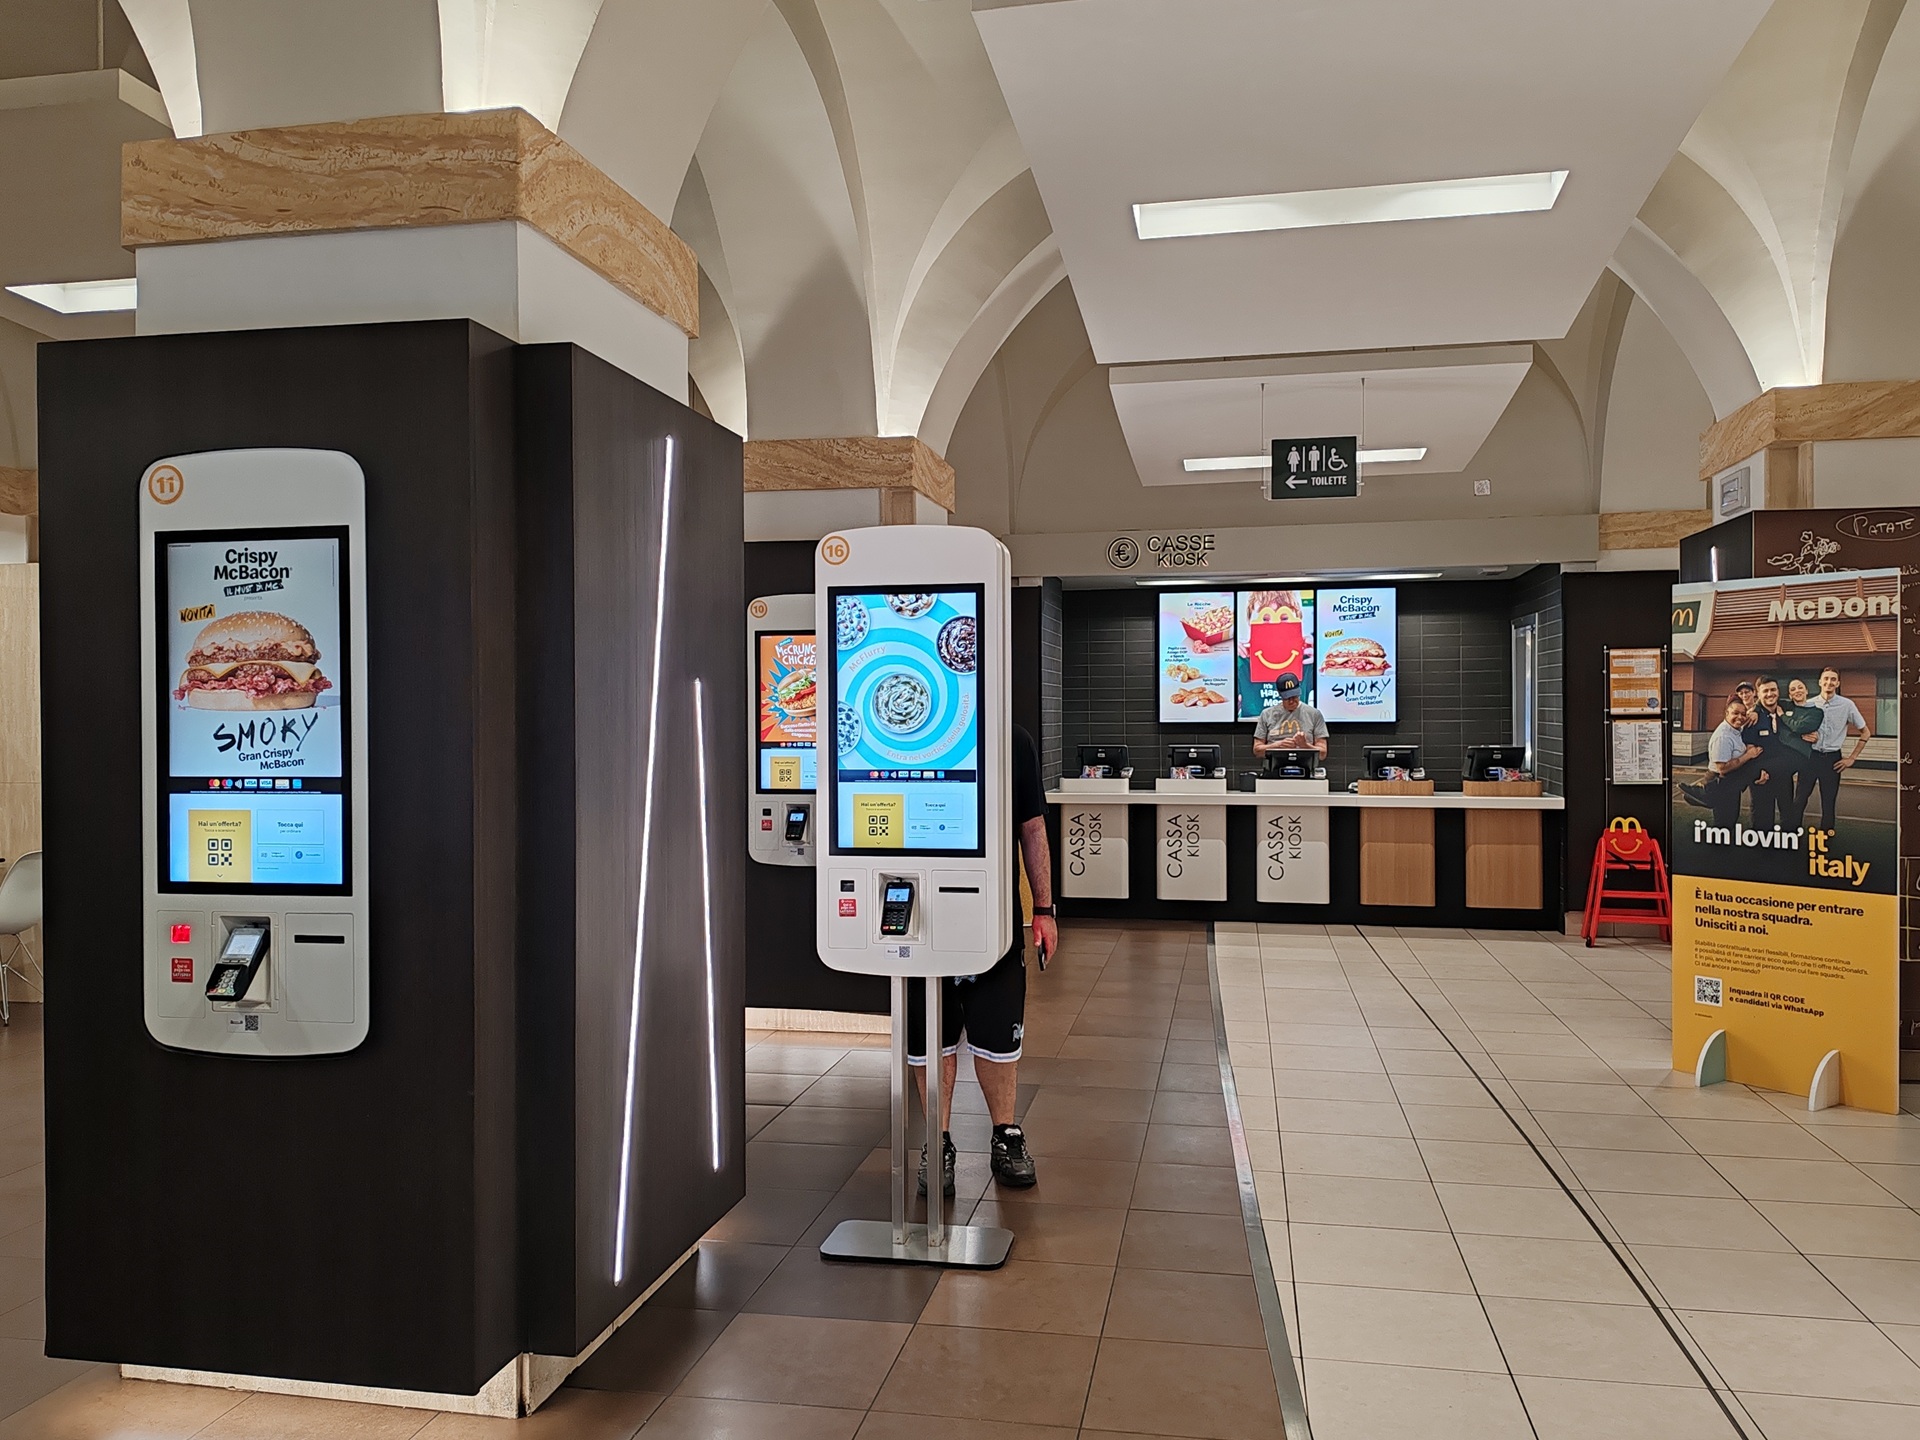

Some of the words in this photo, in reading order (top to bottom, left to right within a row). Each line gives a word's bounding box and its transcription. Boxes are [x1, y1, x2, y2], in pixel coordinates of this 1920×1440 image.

[156, 476, 175, 494] 11
[1311, 475, 1347, 486] TOILETTE
[1853, 514, 1915, 537] PATATE
[826, 544, 844, 558] 16
[1147, 534, 1215, 552] CASSE
[225, 547, 278, 567] Crispy
[1157, 552, 1208, 567] KIOSK
[214, 565, 290, 580] McBacon
[235, 585, 253, 595] MUST
[1332, 604, 1379, 613] McBacon
[1340, 595, 1373, 605] Crispy
[180, 604, 214, 622] NOVITÀ
[753, 605, 764, 614] 10
[775, 643, 816, 658] McCRUNC
[848, 646, 886, 672] McFlurry
[1260, 689, 1280, 698] Hap
[1331, 678, 1391, 697] SMOKY
[213, 712, 318, 752] SMOKY
[886, 750, 907, 761] Entra
[923, 743, 947, 759] vortice
[947, 728, 961, 743] della
[238, 751, 262, 762] Gran
[263, 748, 293, 761] Crispy
[260, 758, 304, 770] McBacon
[1089, 813, 1102, 855] KIOSK
[1187, 814, 1200, 857] KIOSK
[1288, 815, 1302, 859] KIOSK
[1694, 819, 1731, 845] i'm
[1735, 824, 1804, 850] lovin'
[1069, 813, 1085, 876] CASSA
[1166, 814, 1183, 878] CASSA
[1267, 815, 1284, 881] CASSA
[1809, 851, 1870, 886] italy
[1695, 887, 1701, 899] È
[1703, 890, 1713, 900] la
[1715, 892, 1733, 903] tua
[1735, 896, 1794, 909] occasione
[1796, 902, 1817, 912] per
[1818, 905, 1864, 917] entrare
[1695, 904, 1721, 915] nella
[1723, 908, 1759, 920] nostra
[1762, 912, 1813, 926] squadra.
[1695, 917, 1737, 931] Unisciti
[1739, 925, 1746, 933] a
[1748, 924, 1769, 935] noi.
[1762, 963, 1785, 971] persone
[1791, 952, 1823, 961] formazione
[1824, 957, 1851, 965] continua
[1729, 987, 1762, 998] Inquadra
[1770, 992, 1781, 1001] QR
[1783, 995, 1805, 1005] CODE
[1735, 998, 1770, 1008] candidati
[1771, 1001, 1782, 1010] via
[1784, 1004, 1824, 1017] WhatsApp
